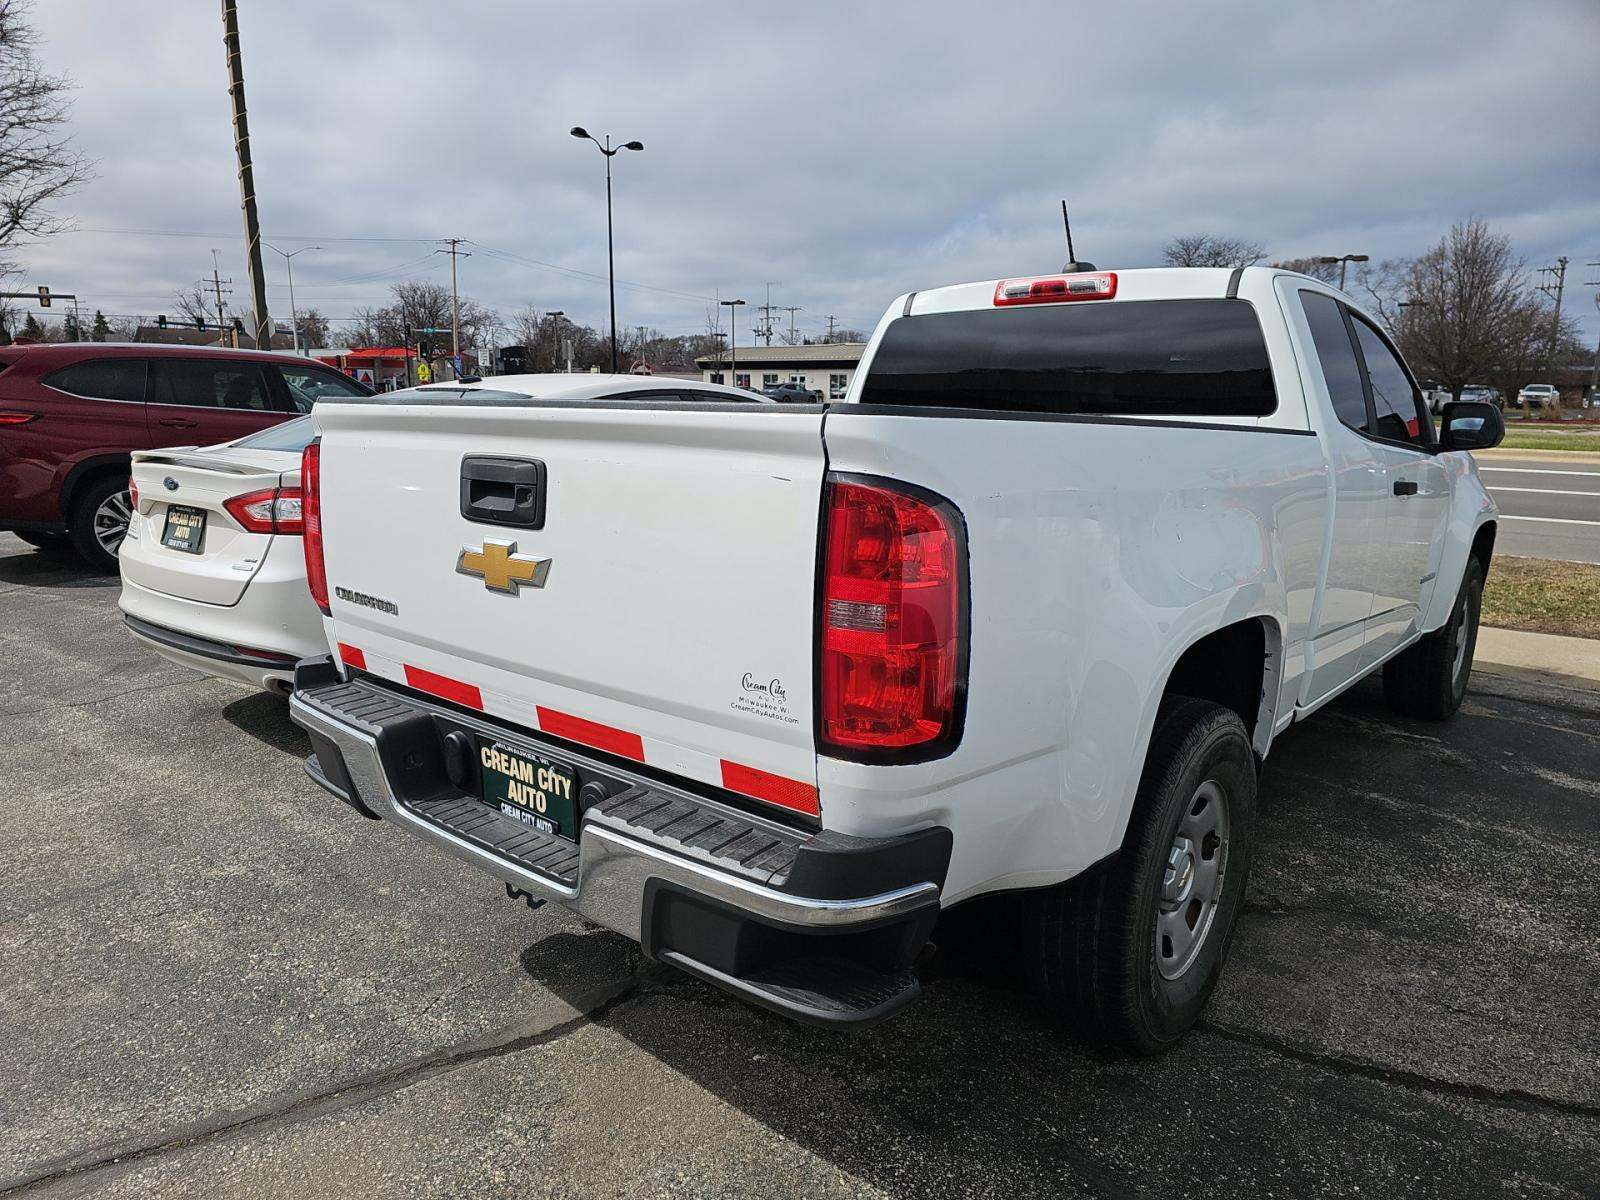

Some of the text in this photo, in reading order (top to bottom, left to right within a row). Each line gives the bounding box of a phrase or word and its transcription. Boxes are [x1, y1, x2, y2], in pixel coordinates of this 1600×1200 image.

[742, 672, 787, 702] Cream City
[730, 702, 799, 724] CreamCityAutos.com
[481, 747, 572, 800] CREAM CITY
[508, 779, 547, 813] AUTO
[500, 802, 553, 834] CREAM CITY AUTO
